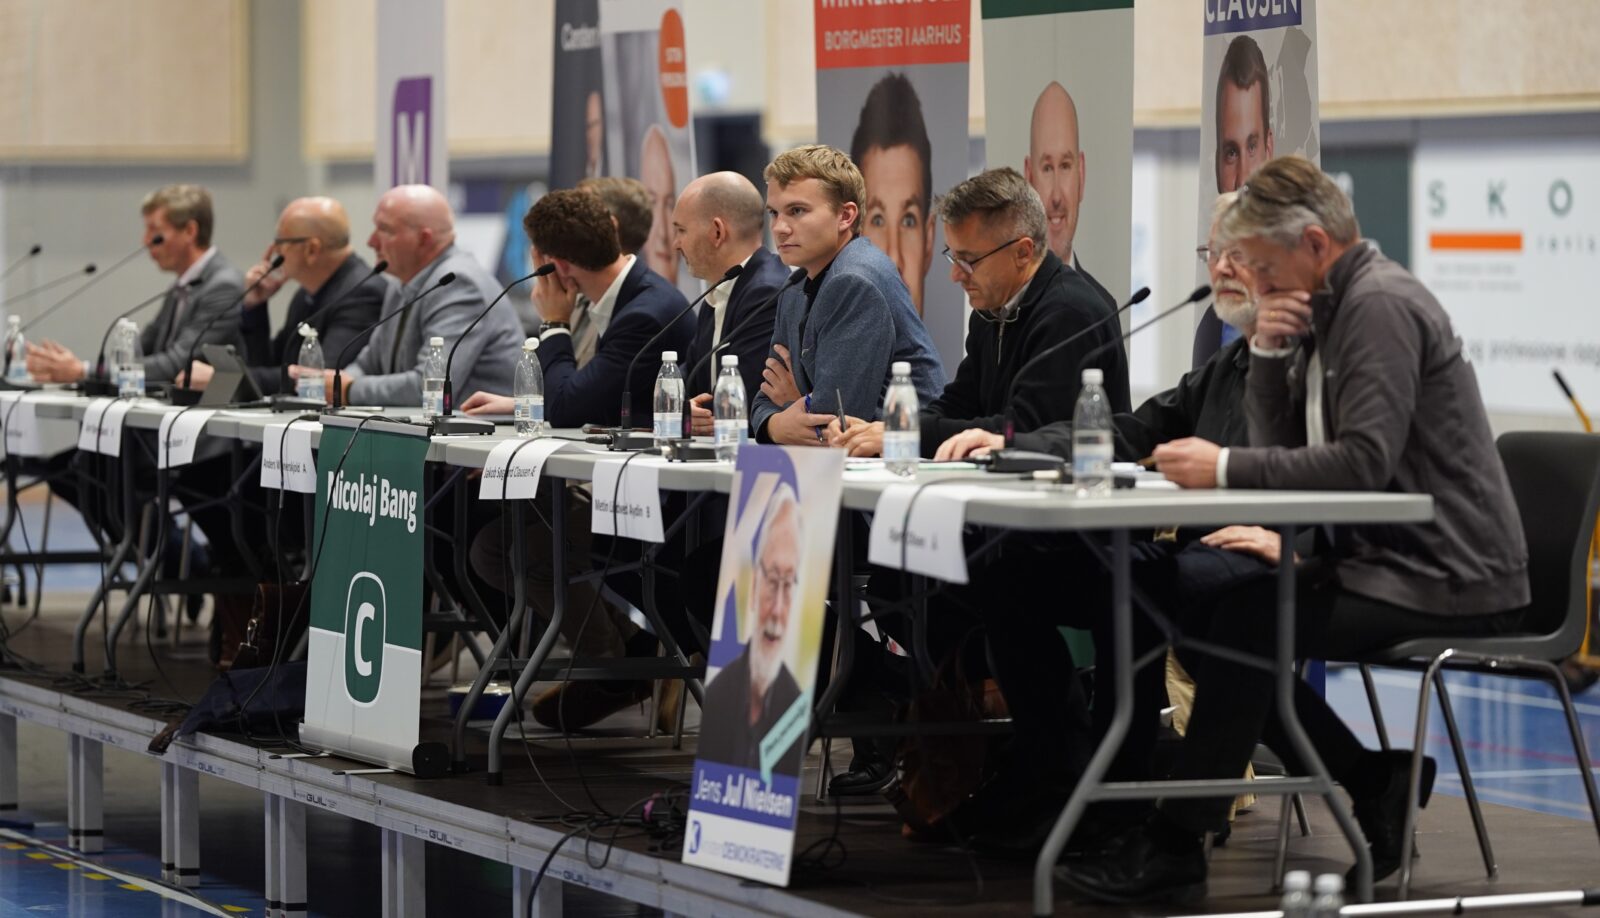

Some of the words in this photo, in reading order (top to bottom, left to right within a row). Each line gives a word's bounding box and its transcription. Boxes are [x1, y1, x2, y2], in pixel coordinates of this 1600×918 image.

[824, 27, 903, 51] BORGMESTER
[911, 24, 961, 45] AARHUS
[483, 467, 497, 479] Jakob
[327, 469, 377, 527] Nicolaj
[379, 477, 417, 533] Bang
[354, 601, 375, 677] C
[198, 762, 217, 775] GUIL
[306, 793, 327, 806] GUIL
[694, 769, 722, 804] Jens
[722, 773, 744, 808] Jul
[742, 777, 793, 818] Nielsen
[429, 829, 453, 845] GUIL
[563, 870, 590, 886] GUIL
